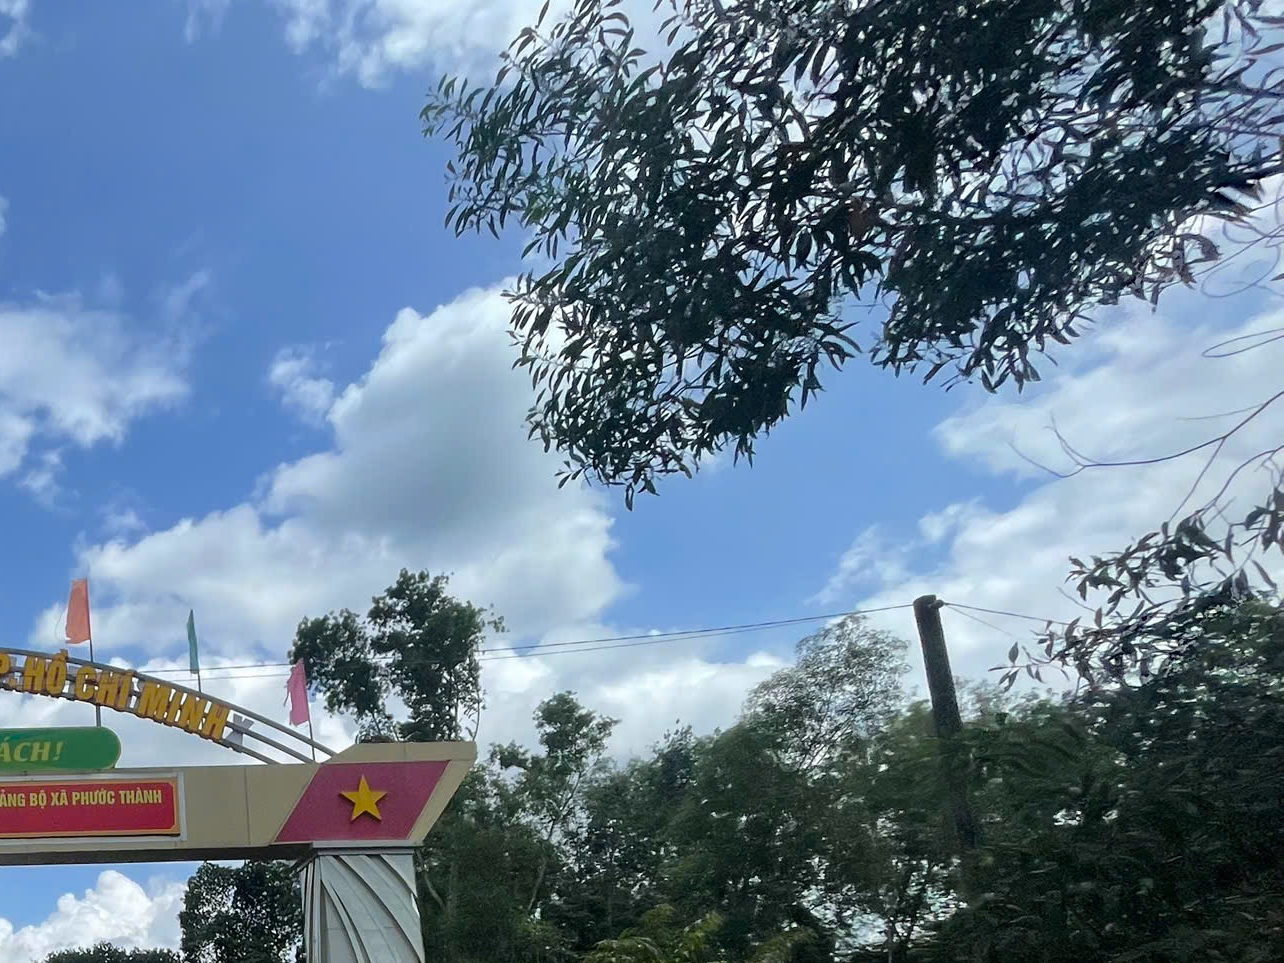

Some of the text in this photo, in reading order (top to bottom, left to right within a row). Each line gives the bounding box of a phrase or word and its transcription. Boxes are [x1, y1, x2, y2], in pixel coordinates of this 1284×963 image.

[75, 665, 134, 710] CHÍ
[137, 680, 230, 741] MINH
[29, 789, 48, 809] BỘ
[50, 789, 68, 806] XÃ
[71, 787, 116, 806] PHƯỚC
[118, 786, 163, 804] THÀNH
